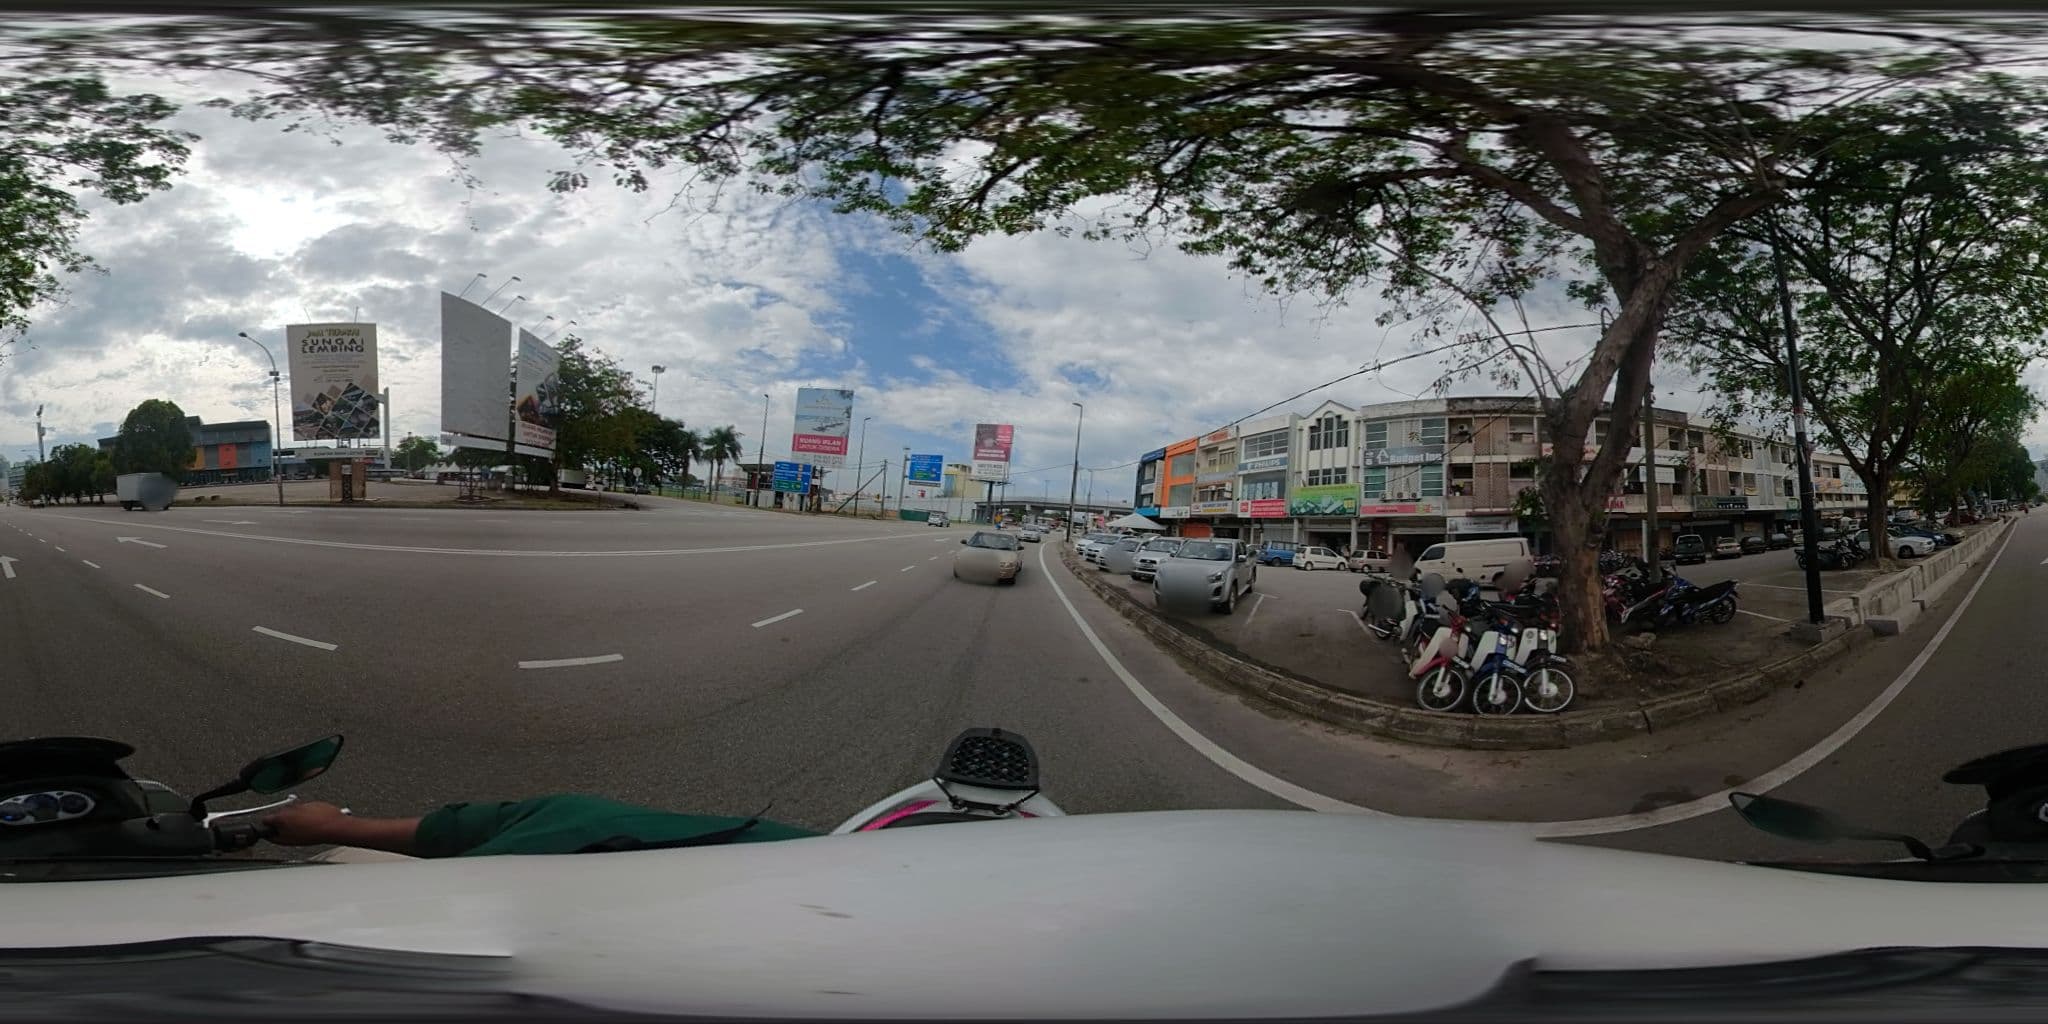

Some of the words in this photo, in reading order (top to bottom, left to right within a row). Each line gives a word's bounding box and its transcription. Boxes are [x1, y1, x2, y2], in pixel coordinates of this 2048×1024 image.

[302, 338, 364, 346] SUNGAI
[302, 345, 364, 353] LEMBING
[1390, 453, 1424, 464] Budget
